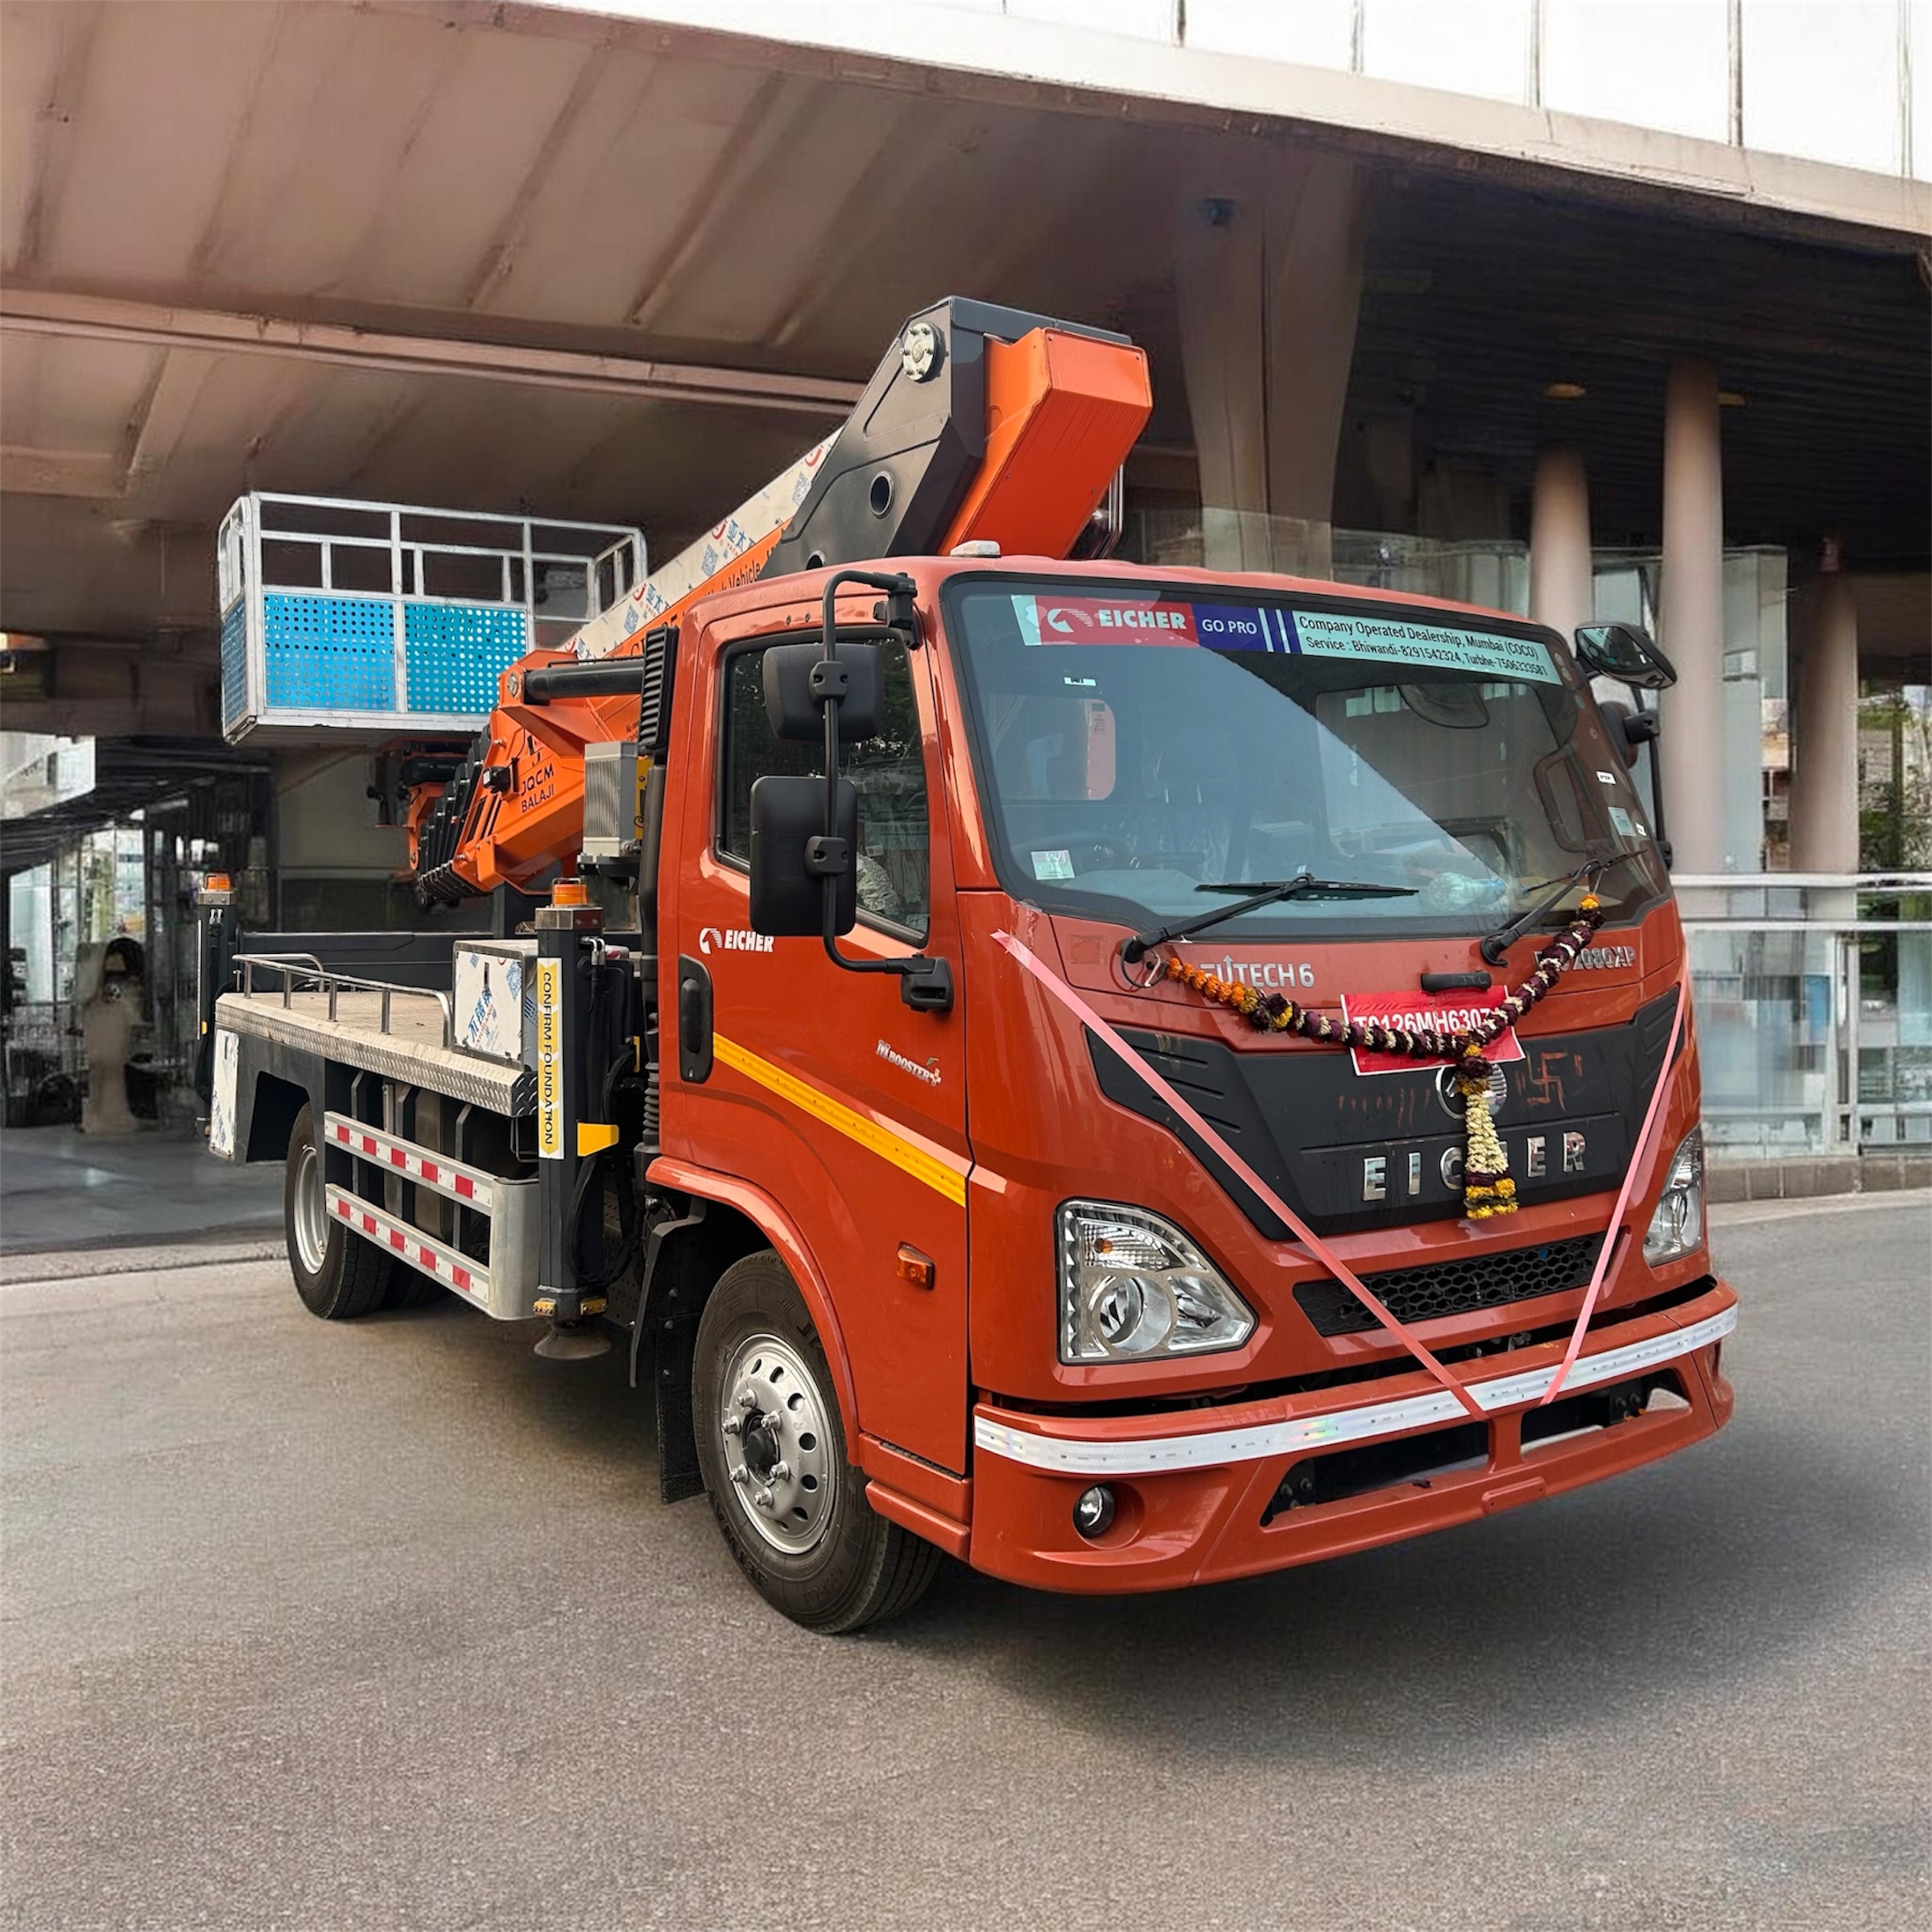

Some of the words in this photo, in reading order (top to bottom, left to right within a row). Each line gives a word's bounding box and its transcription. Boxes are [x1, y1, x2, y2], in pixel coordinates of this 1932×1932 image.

[729, 559, 761, 588] Vehicle
[1100, 609, 1187, 630] EICHER
[1202, 619, 1224, 634] GO
[1228, 621, 1257, 635] PRO
[1299, 616, 1353, 635] Company
[1356, 621, 1406, 638] Operated
[1407, 627, 1465, 648] Dealership,
[1465, 635, 1505, 652] Mumbai
[1505, 642, 1539, 661] (COCO)
[1306, 636, 1346, 651] Service
[521, 762, 555, 797] JQCM
[521, 782, 555, 813] BALAJI
[724, 928, 775, 953] EICHER
[1298, 963, 1315, 989] 6
[543, 972, 552, 1041] CONFIRM
[543, 1044, 553, 1145] FOUNDATION
[1363, 1131, 1587, 1201] EICER
